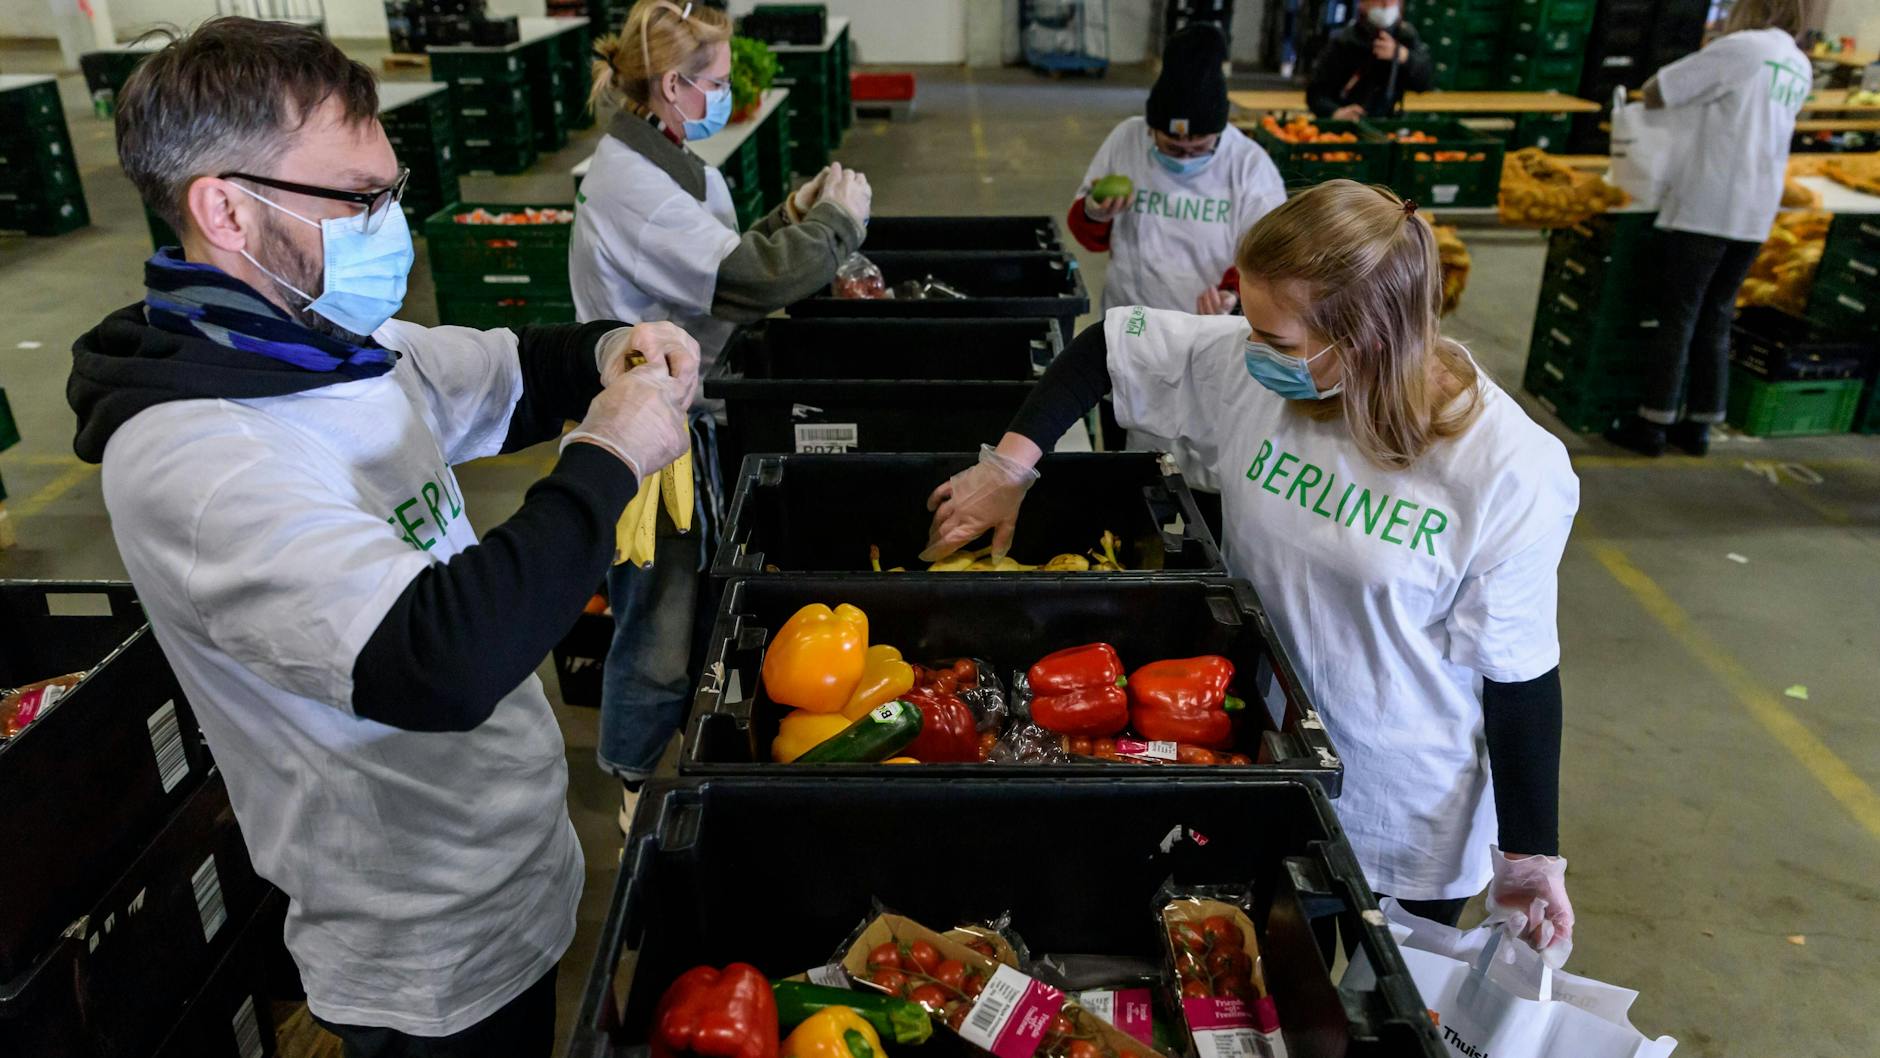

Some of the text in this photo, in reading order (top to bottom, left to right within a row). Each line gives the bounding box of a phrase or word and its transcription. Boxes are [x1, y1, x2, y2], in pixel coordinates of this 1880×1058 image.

[1133, 188, 1233, 224] ERLINER
[1246, 439, 1449, 556] BERLINER
[1444, 1026, 1489, 1058] Thuis
